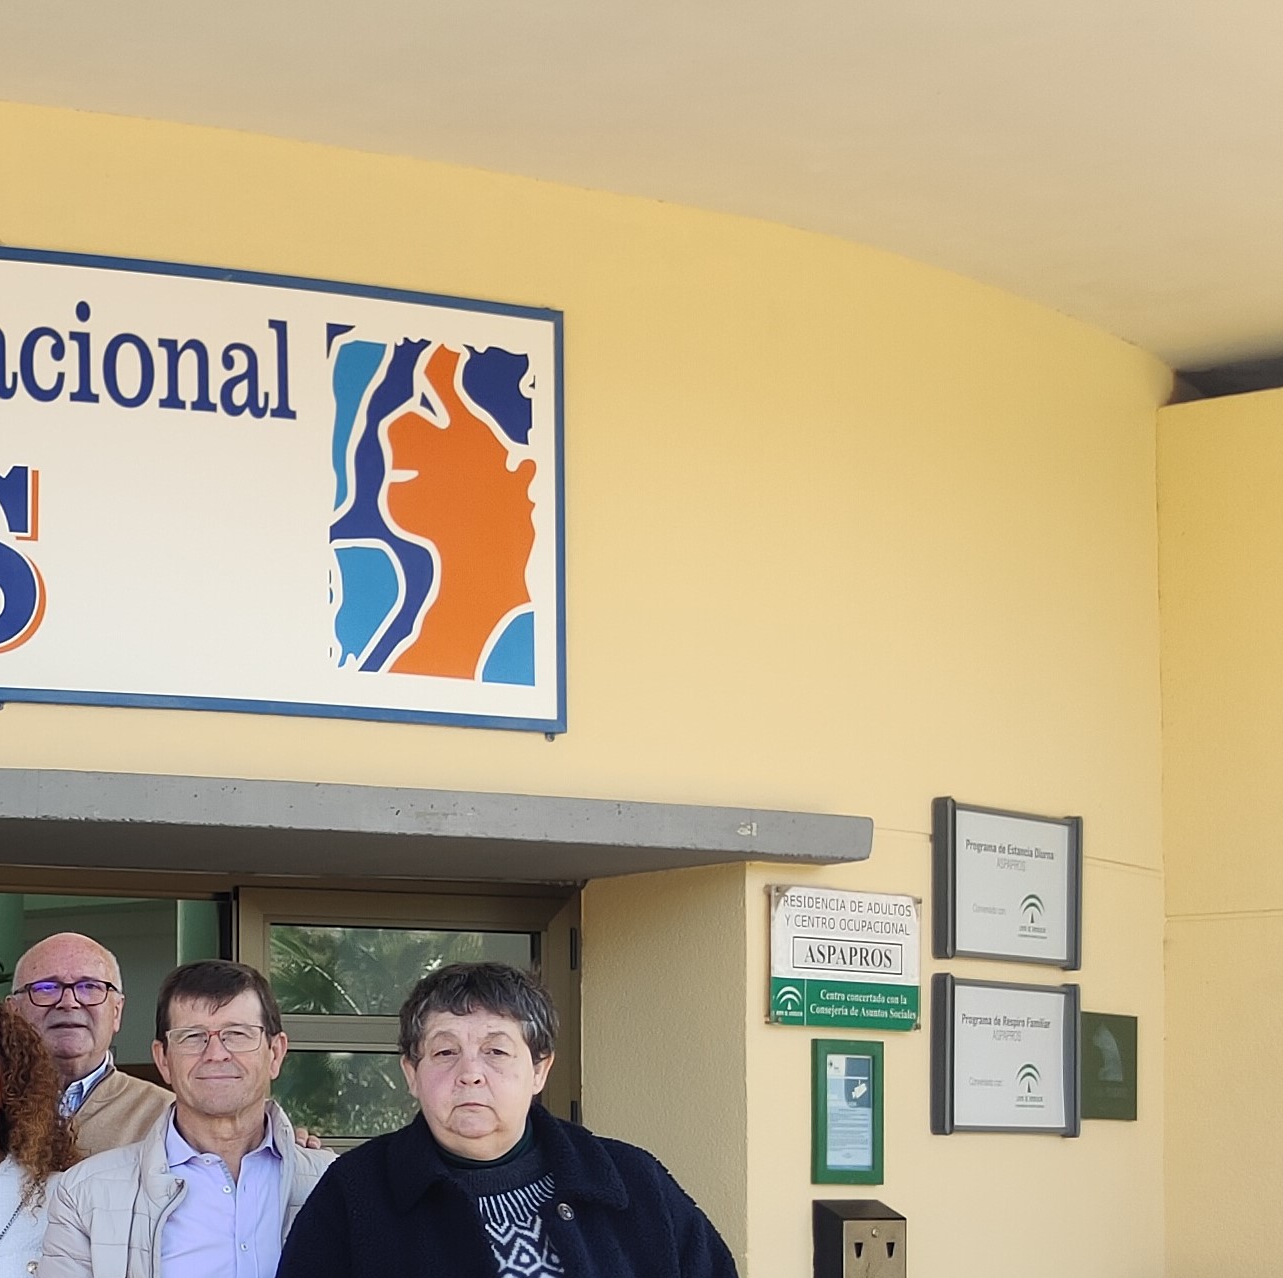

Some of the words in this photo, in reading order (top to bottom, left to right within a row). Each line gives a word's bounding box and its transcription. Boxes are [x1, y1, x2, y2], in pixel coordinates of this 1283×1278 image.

[965, 839, 997, 854] Programa
[998, 843, 1005, 854] de
[1007, 844, 1033, 858] Estancia
[1035, 847, 1054, 860] Diurna
[783, 894, 846, 912] RESIDENCIA
[849, 900, 863, 913] DE
[867, 902, 912, 917] ADULTOS
[785, 914, 791, 926] Y
[794, 914, 836, 930] CENTRO
[839, 918, 911, 936] OCUPACIONAL
[804, 943, 893, 969] ASPAPROS
[820, 990, 845, 1001] Centro
[847, 992, 885, 1004] concertado
[887, 996, 899, 1004] con
[900, 994, 907, 1005] la
[809, 1004, 848, 1018] Consejería
[850, 1006, 859, 1016] de
[859, 1006, 888, 1018] Asuntos
[889, 1008, 917, 1020] Sociales
[961, 1013, 992, 1027] Programa
[993, 1016, 1001, 1026] de
[1003, 1016, 1025, 1028] Respiro
[1027, 1016, 1051, 1028] Familiar
